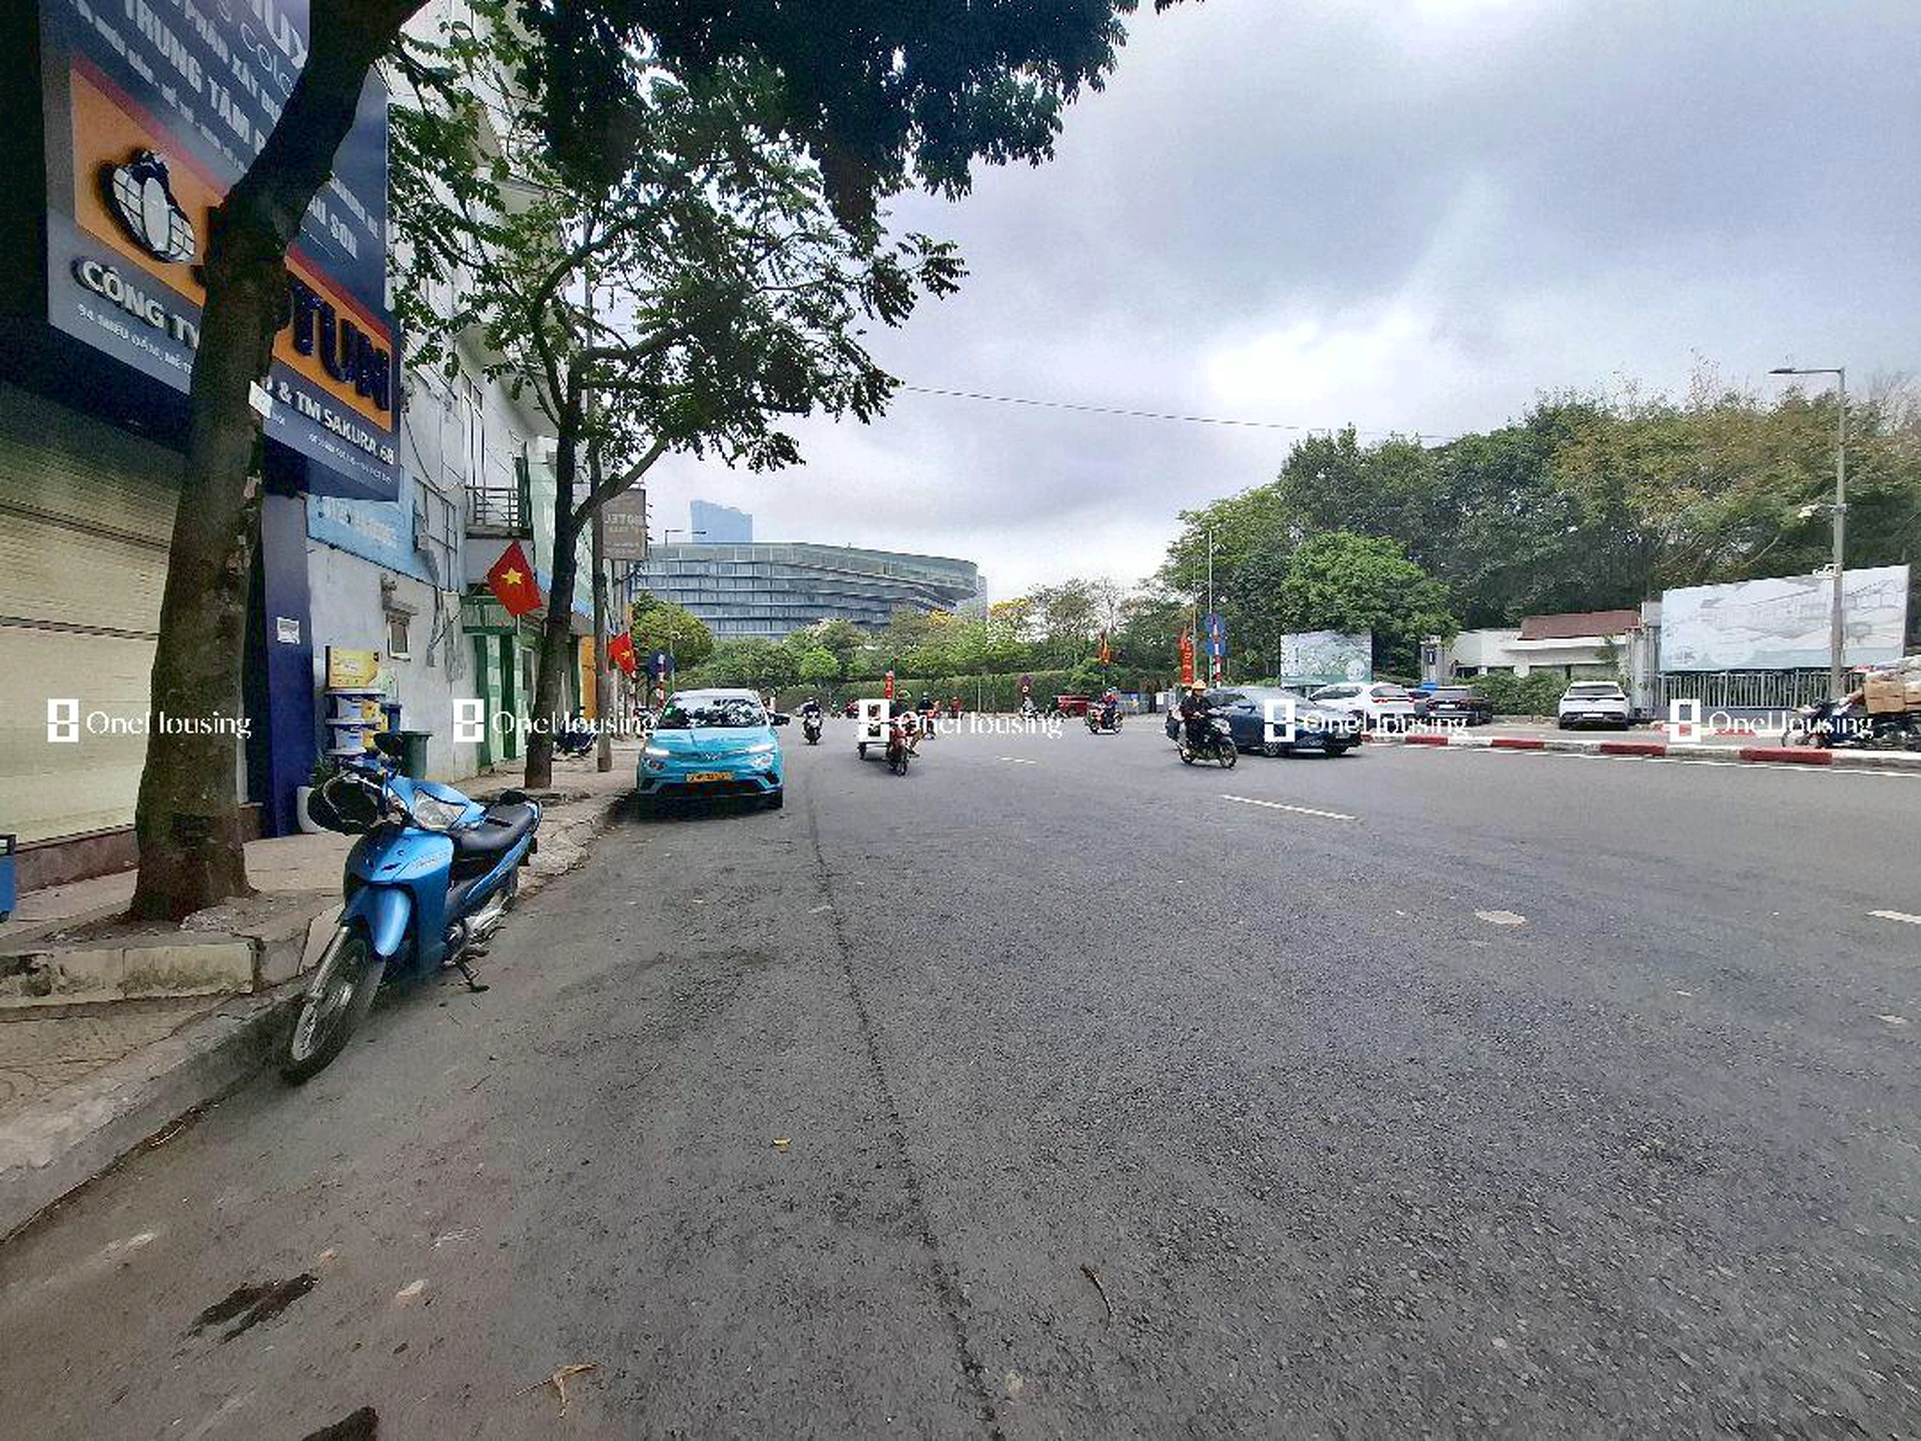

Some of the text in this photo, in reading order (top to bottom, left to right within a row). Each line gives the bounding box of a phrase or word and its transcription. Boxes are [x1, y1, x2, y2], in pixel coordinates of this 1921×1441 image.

[83, 260, 165, 328] CÔNG
[296, 391, 321, 421] TM
[322, 408, 378, 456] SAKURA
